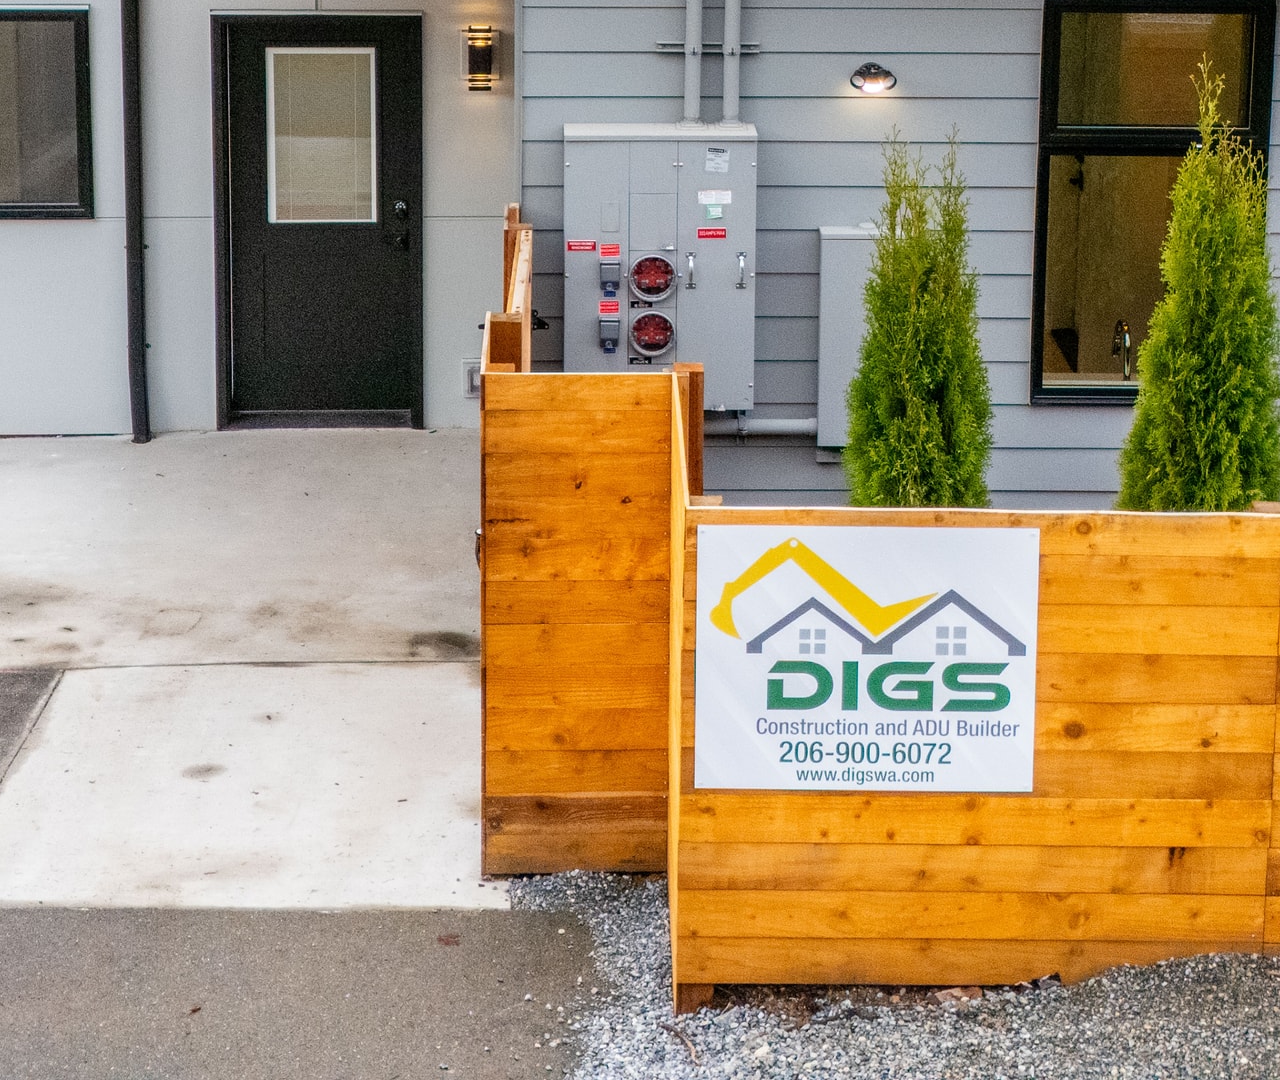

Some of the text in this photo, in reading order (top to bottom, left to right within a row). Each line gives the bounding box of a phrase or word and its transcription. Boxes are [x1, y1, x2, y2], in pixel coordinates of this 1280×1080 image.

[766, 660, 1011, 712] DIGS
[756, 717, 1020, 738] Construction and ADU Builder
[778, 740, 952, 765] 206-900-6072
[796, 767, 935, 786] www.digswa.com
